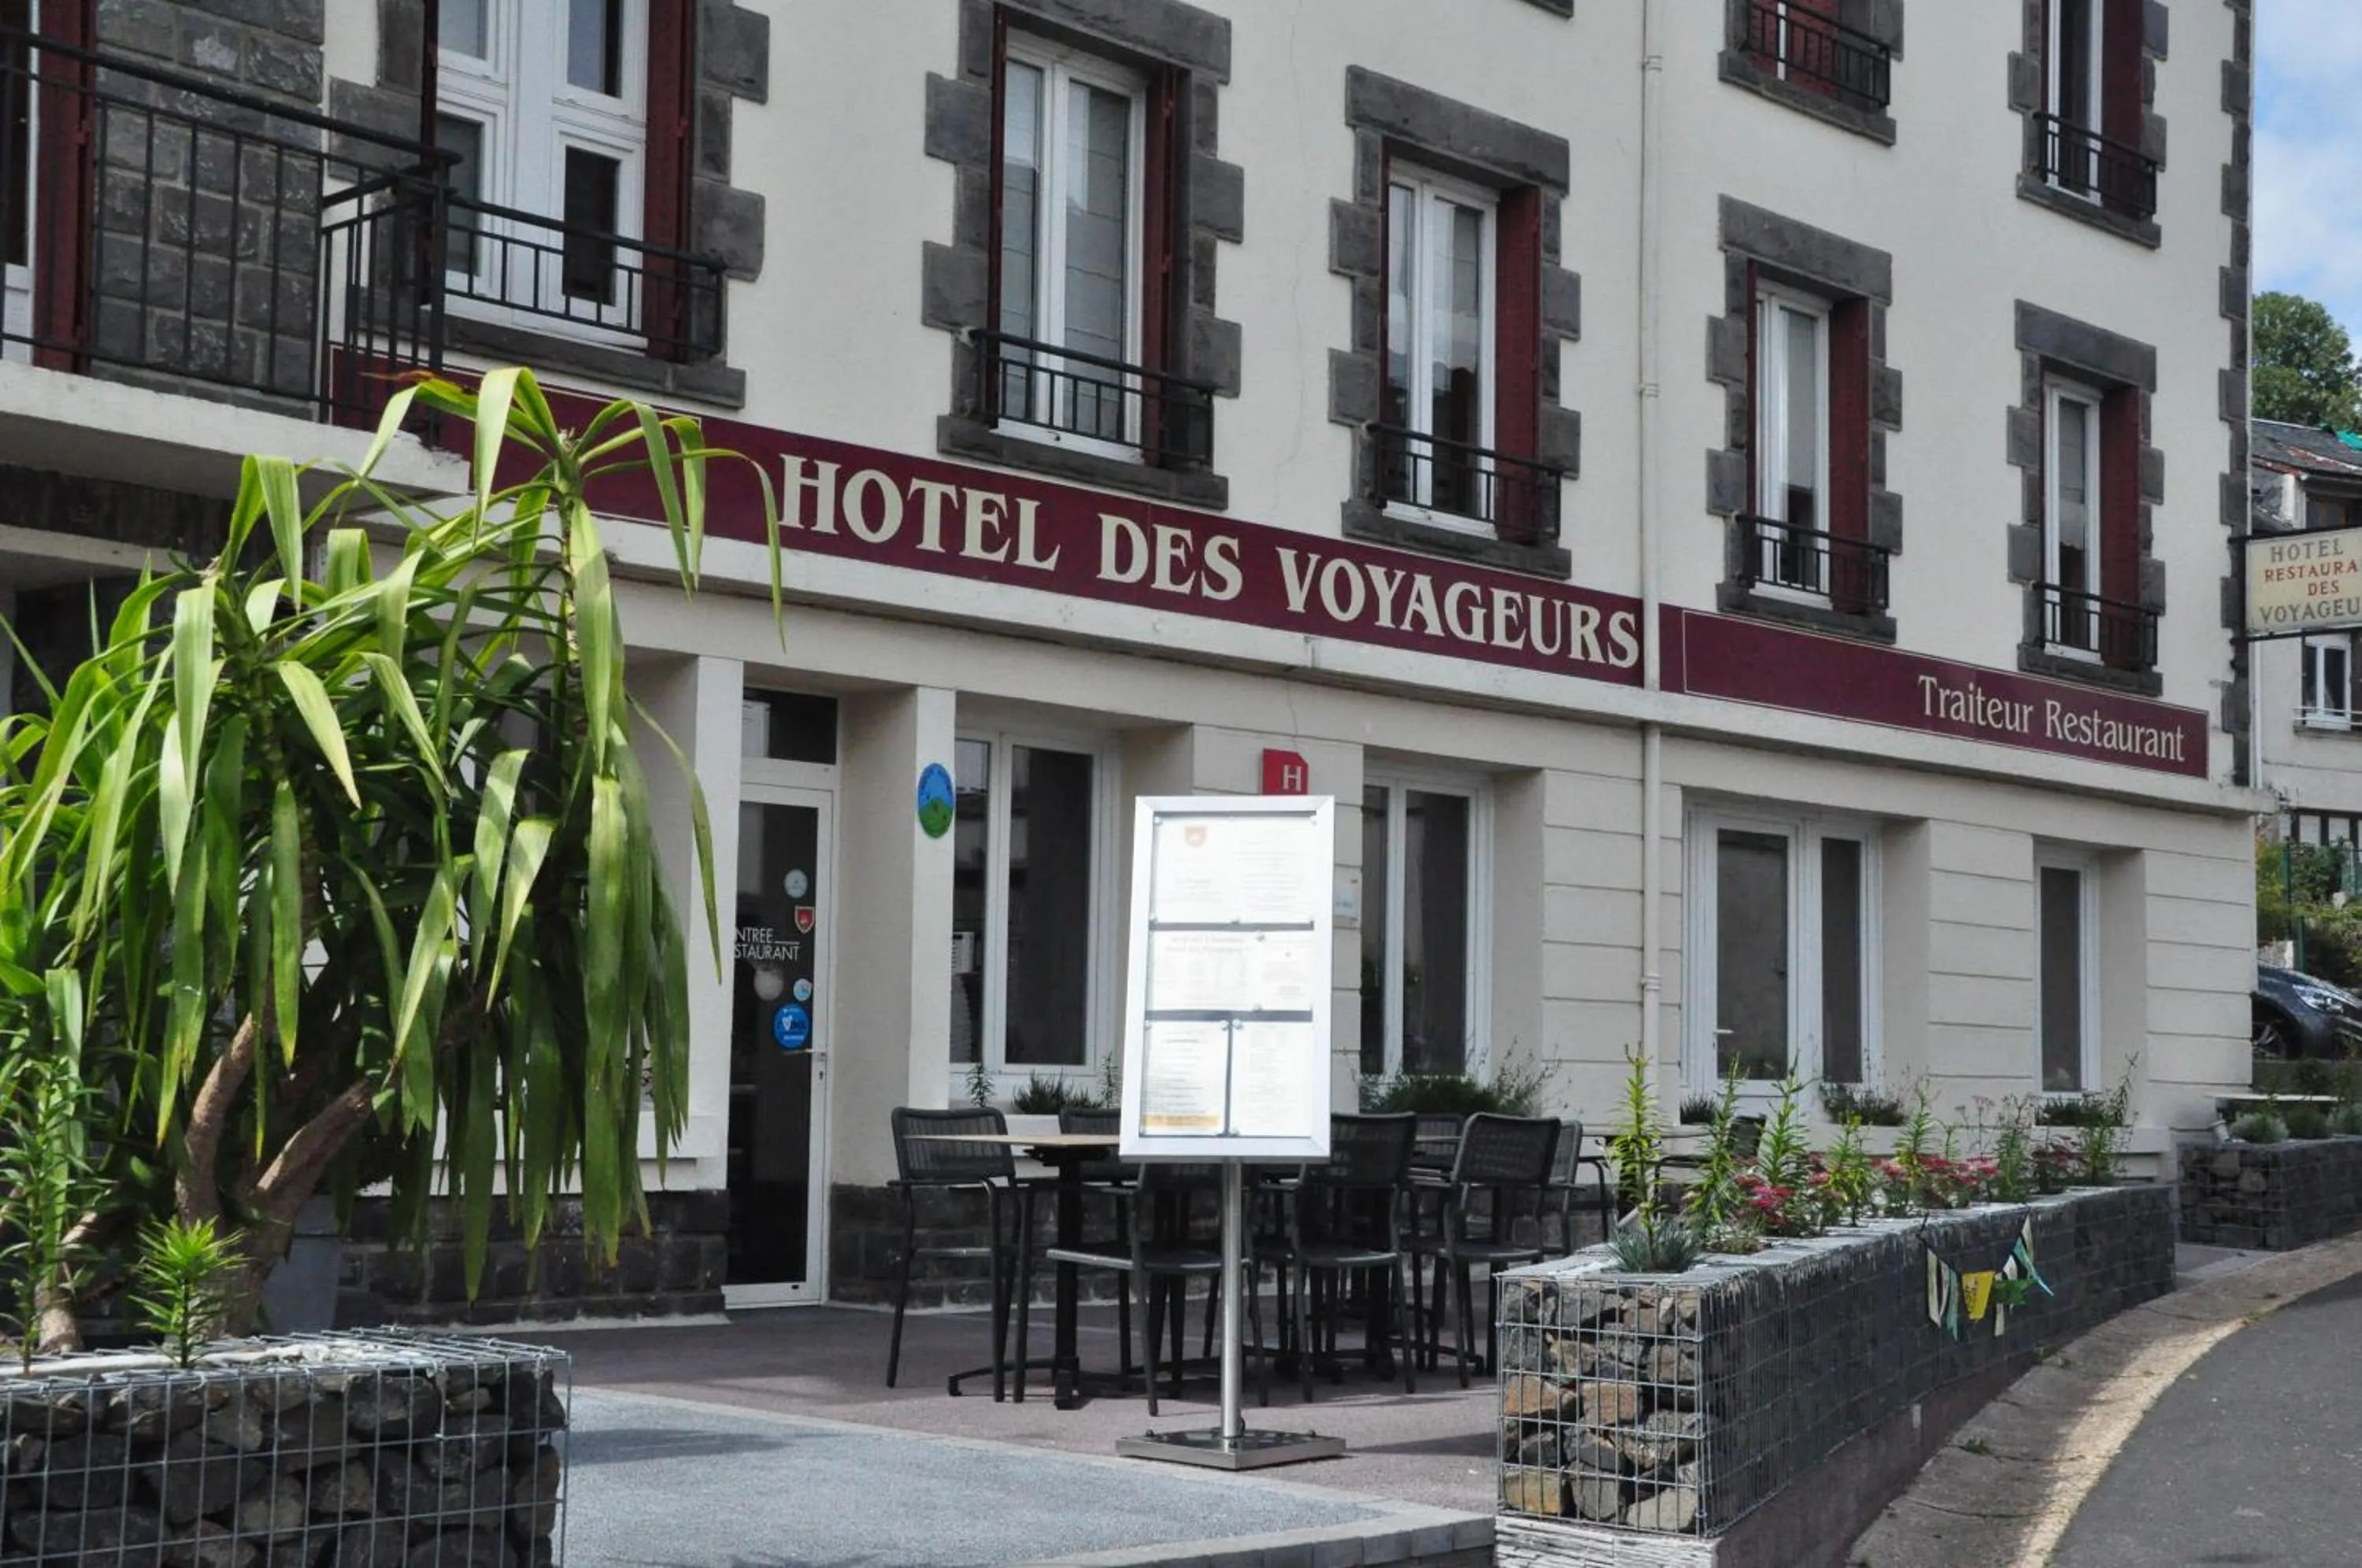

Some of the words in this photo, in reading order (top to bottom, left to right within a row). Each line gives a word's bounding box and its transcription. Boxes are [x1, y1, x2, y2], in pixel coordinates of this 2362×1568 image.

[778, 452, 1061, 572] HOTEL
[1095, 512, 1244, 601] DES
[1275, 545, 1640, 669] VOYAGEURS
[2270, 538, 2344, 563] HOTEL
[2307, 580, 2340, 596] DES
[1918, 675, 2034, 734] Traiteur
[2045, 700, 2186, 761] Restaurant
[1283, 764, 1302, 793] H
